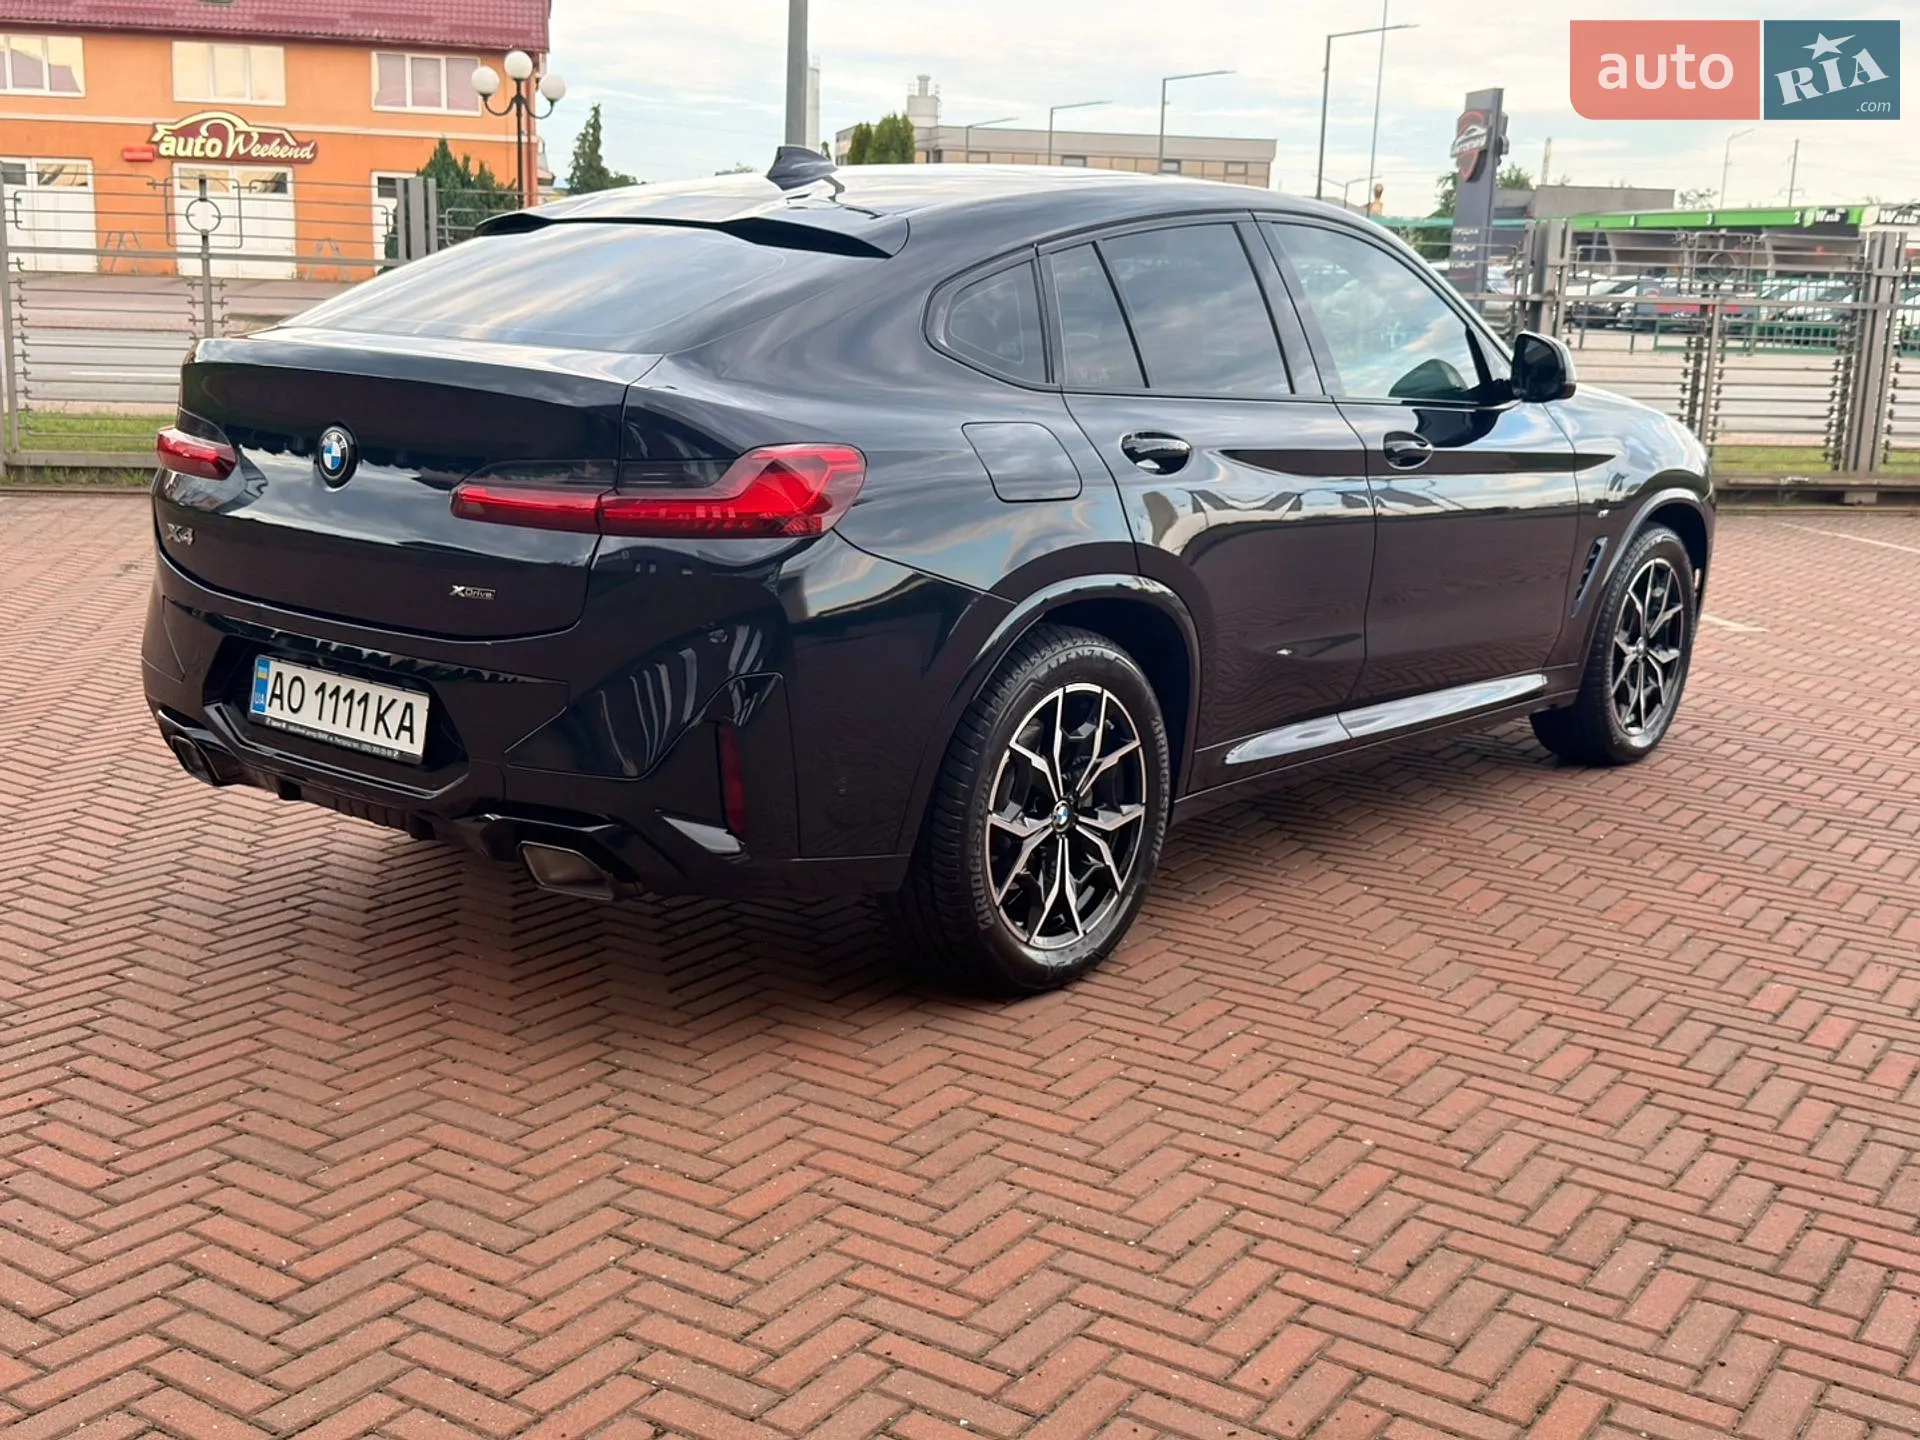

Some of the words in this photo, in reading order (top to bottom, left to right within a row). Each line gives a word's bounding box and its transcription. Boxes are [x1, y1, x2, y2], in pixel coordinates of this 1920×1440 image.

[159, 135, 223, 158] auto
[200, 118, 316, 160] Weekend
[167, 522, 195, 546] X4
[268, 671, 305, 714] AO
